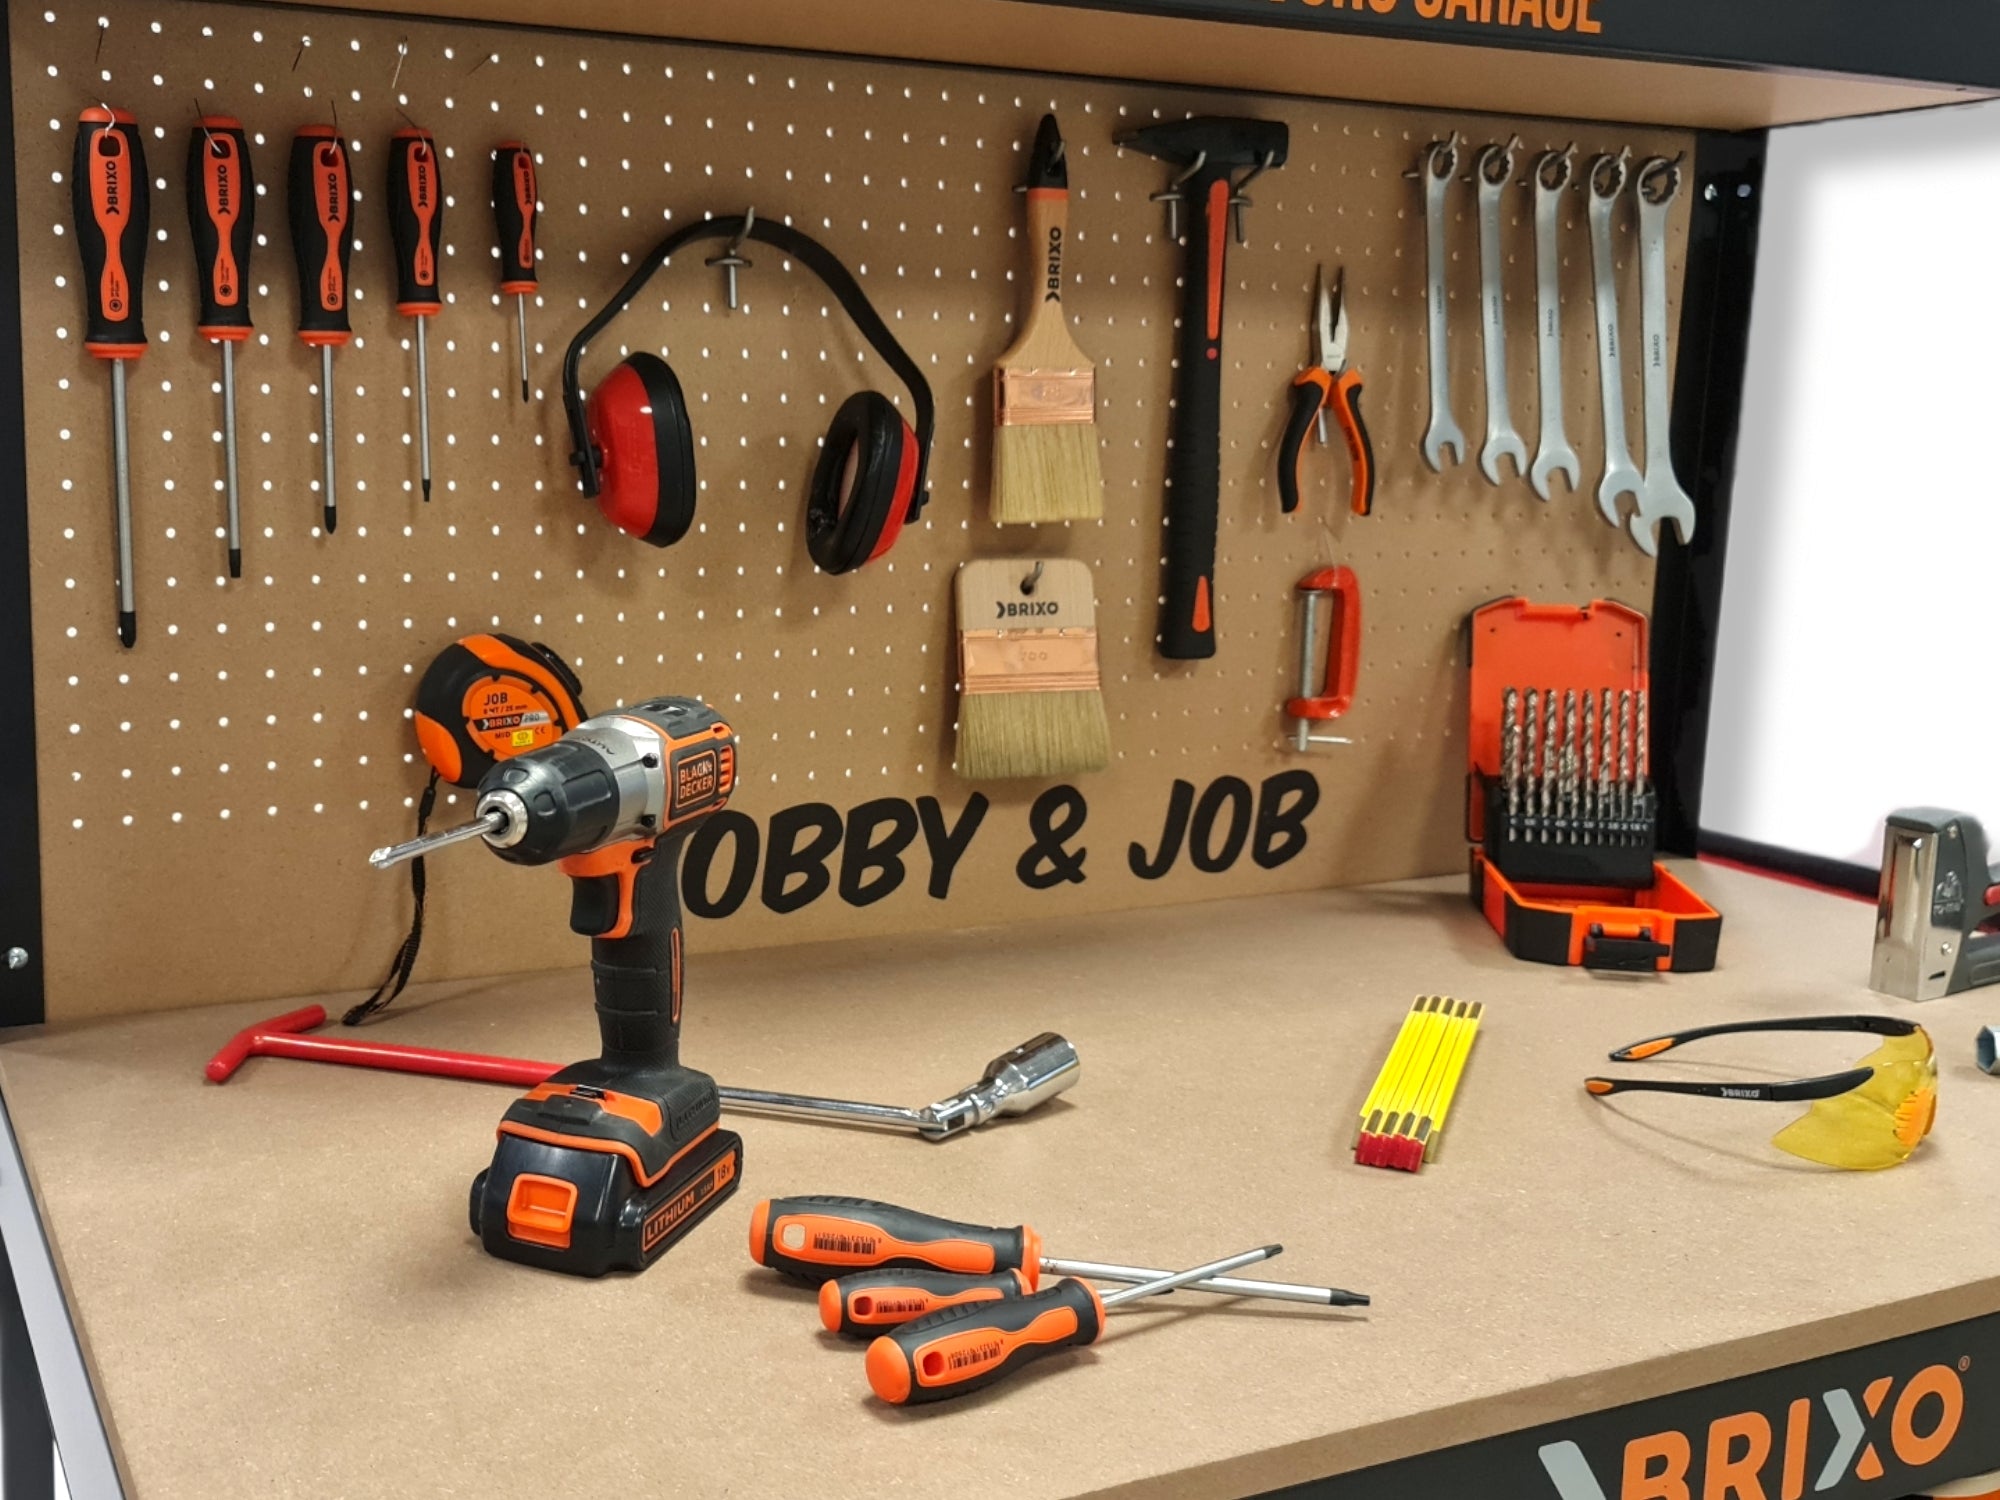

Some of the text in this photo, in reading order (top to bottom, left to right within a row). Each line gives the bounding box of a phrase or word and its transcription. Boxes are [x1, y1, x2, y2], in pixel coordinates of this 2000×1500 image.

[106, 160, 118, 206] BRIXO
[217, 164, 230, 206] BRIXO
[327, 173, 340, 216] BRIXO
[418, 165, 428, 201] BRIXO
[1047, 226, 1062, 290] BRIXO
[1007, 601, 1059, 617] BRIXO
[484, 692, 508, 706] JOB
[488, 716, 520, 728] BRIXO
[680, 775, 713, 800] DECKER
[681, 769, 1320, 918] OBBY & JOB
[646, 1190, 695, 1241] LITHIUM
